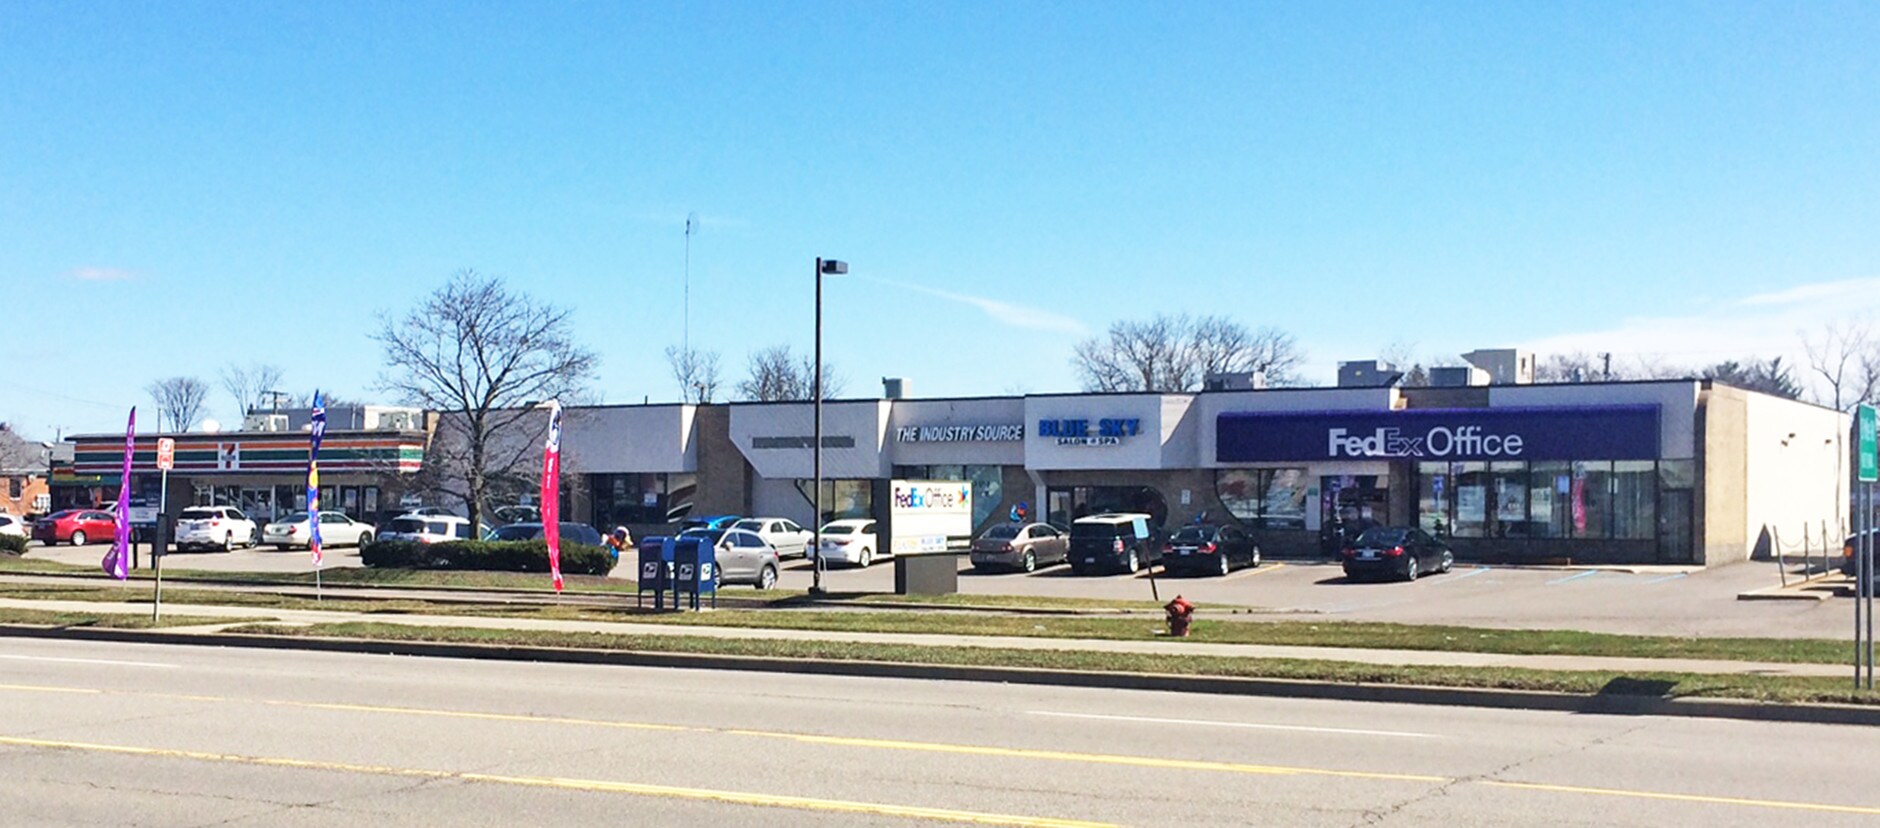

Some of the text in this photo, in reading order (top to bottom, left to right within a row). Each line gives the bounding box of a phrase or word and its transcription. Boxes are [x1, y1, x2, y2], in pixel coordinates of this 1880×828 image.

[897, 425, 1023, 442] THE INDUSTRY SOURCE
[1039, 418, 1140, 437] BLUE SKY
[1057, 437, 1088, 446] SALON
[1098, 437, 1119, 446] SPA
[1329, 426, 1523, 457] FedEx Office
[895, 487, 954, 508] FedEx Office
